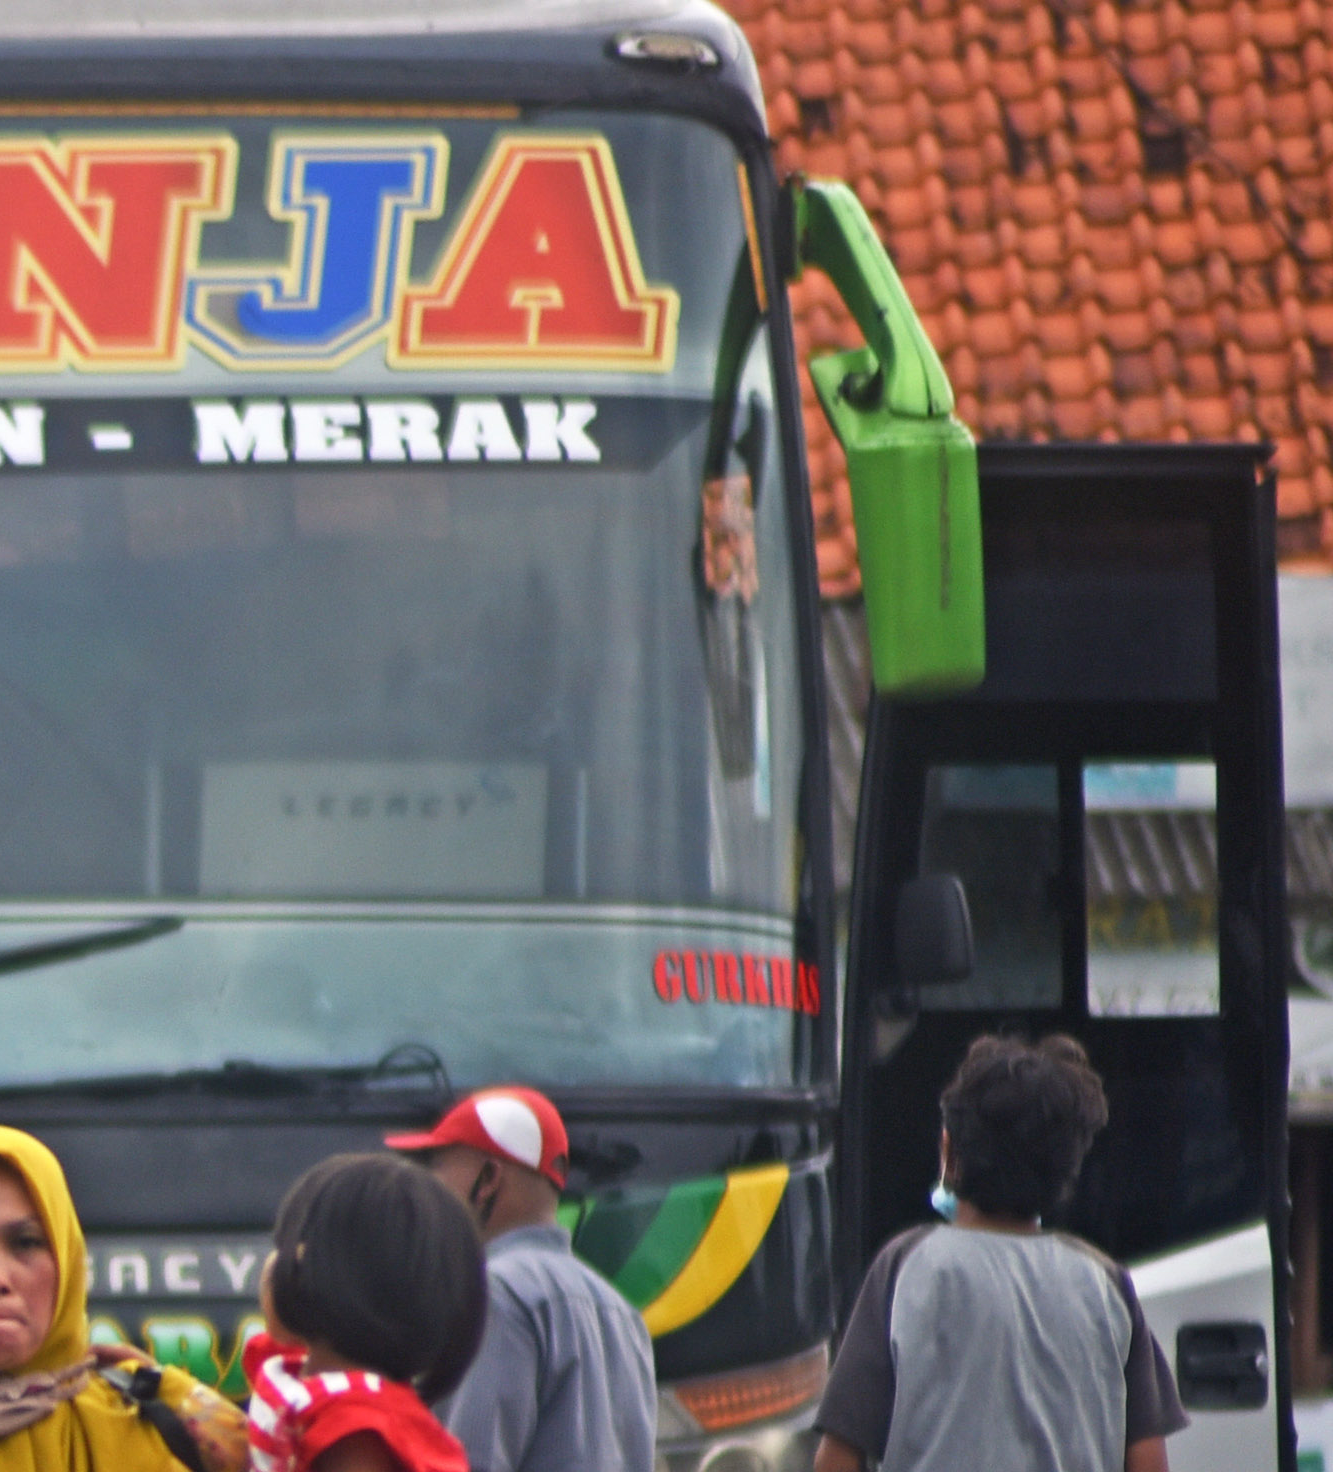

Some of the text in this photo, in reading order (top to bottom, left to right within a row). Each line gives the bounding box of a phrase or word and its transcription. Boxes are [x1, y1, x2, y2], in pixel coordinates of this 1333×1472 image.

[90, 428, 131, 450] -
[194, 400, 600, 464] MERAK
[88, 1253, 256, 1293] ACY
